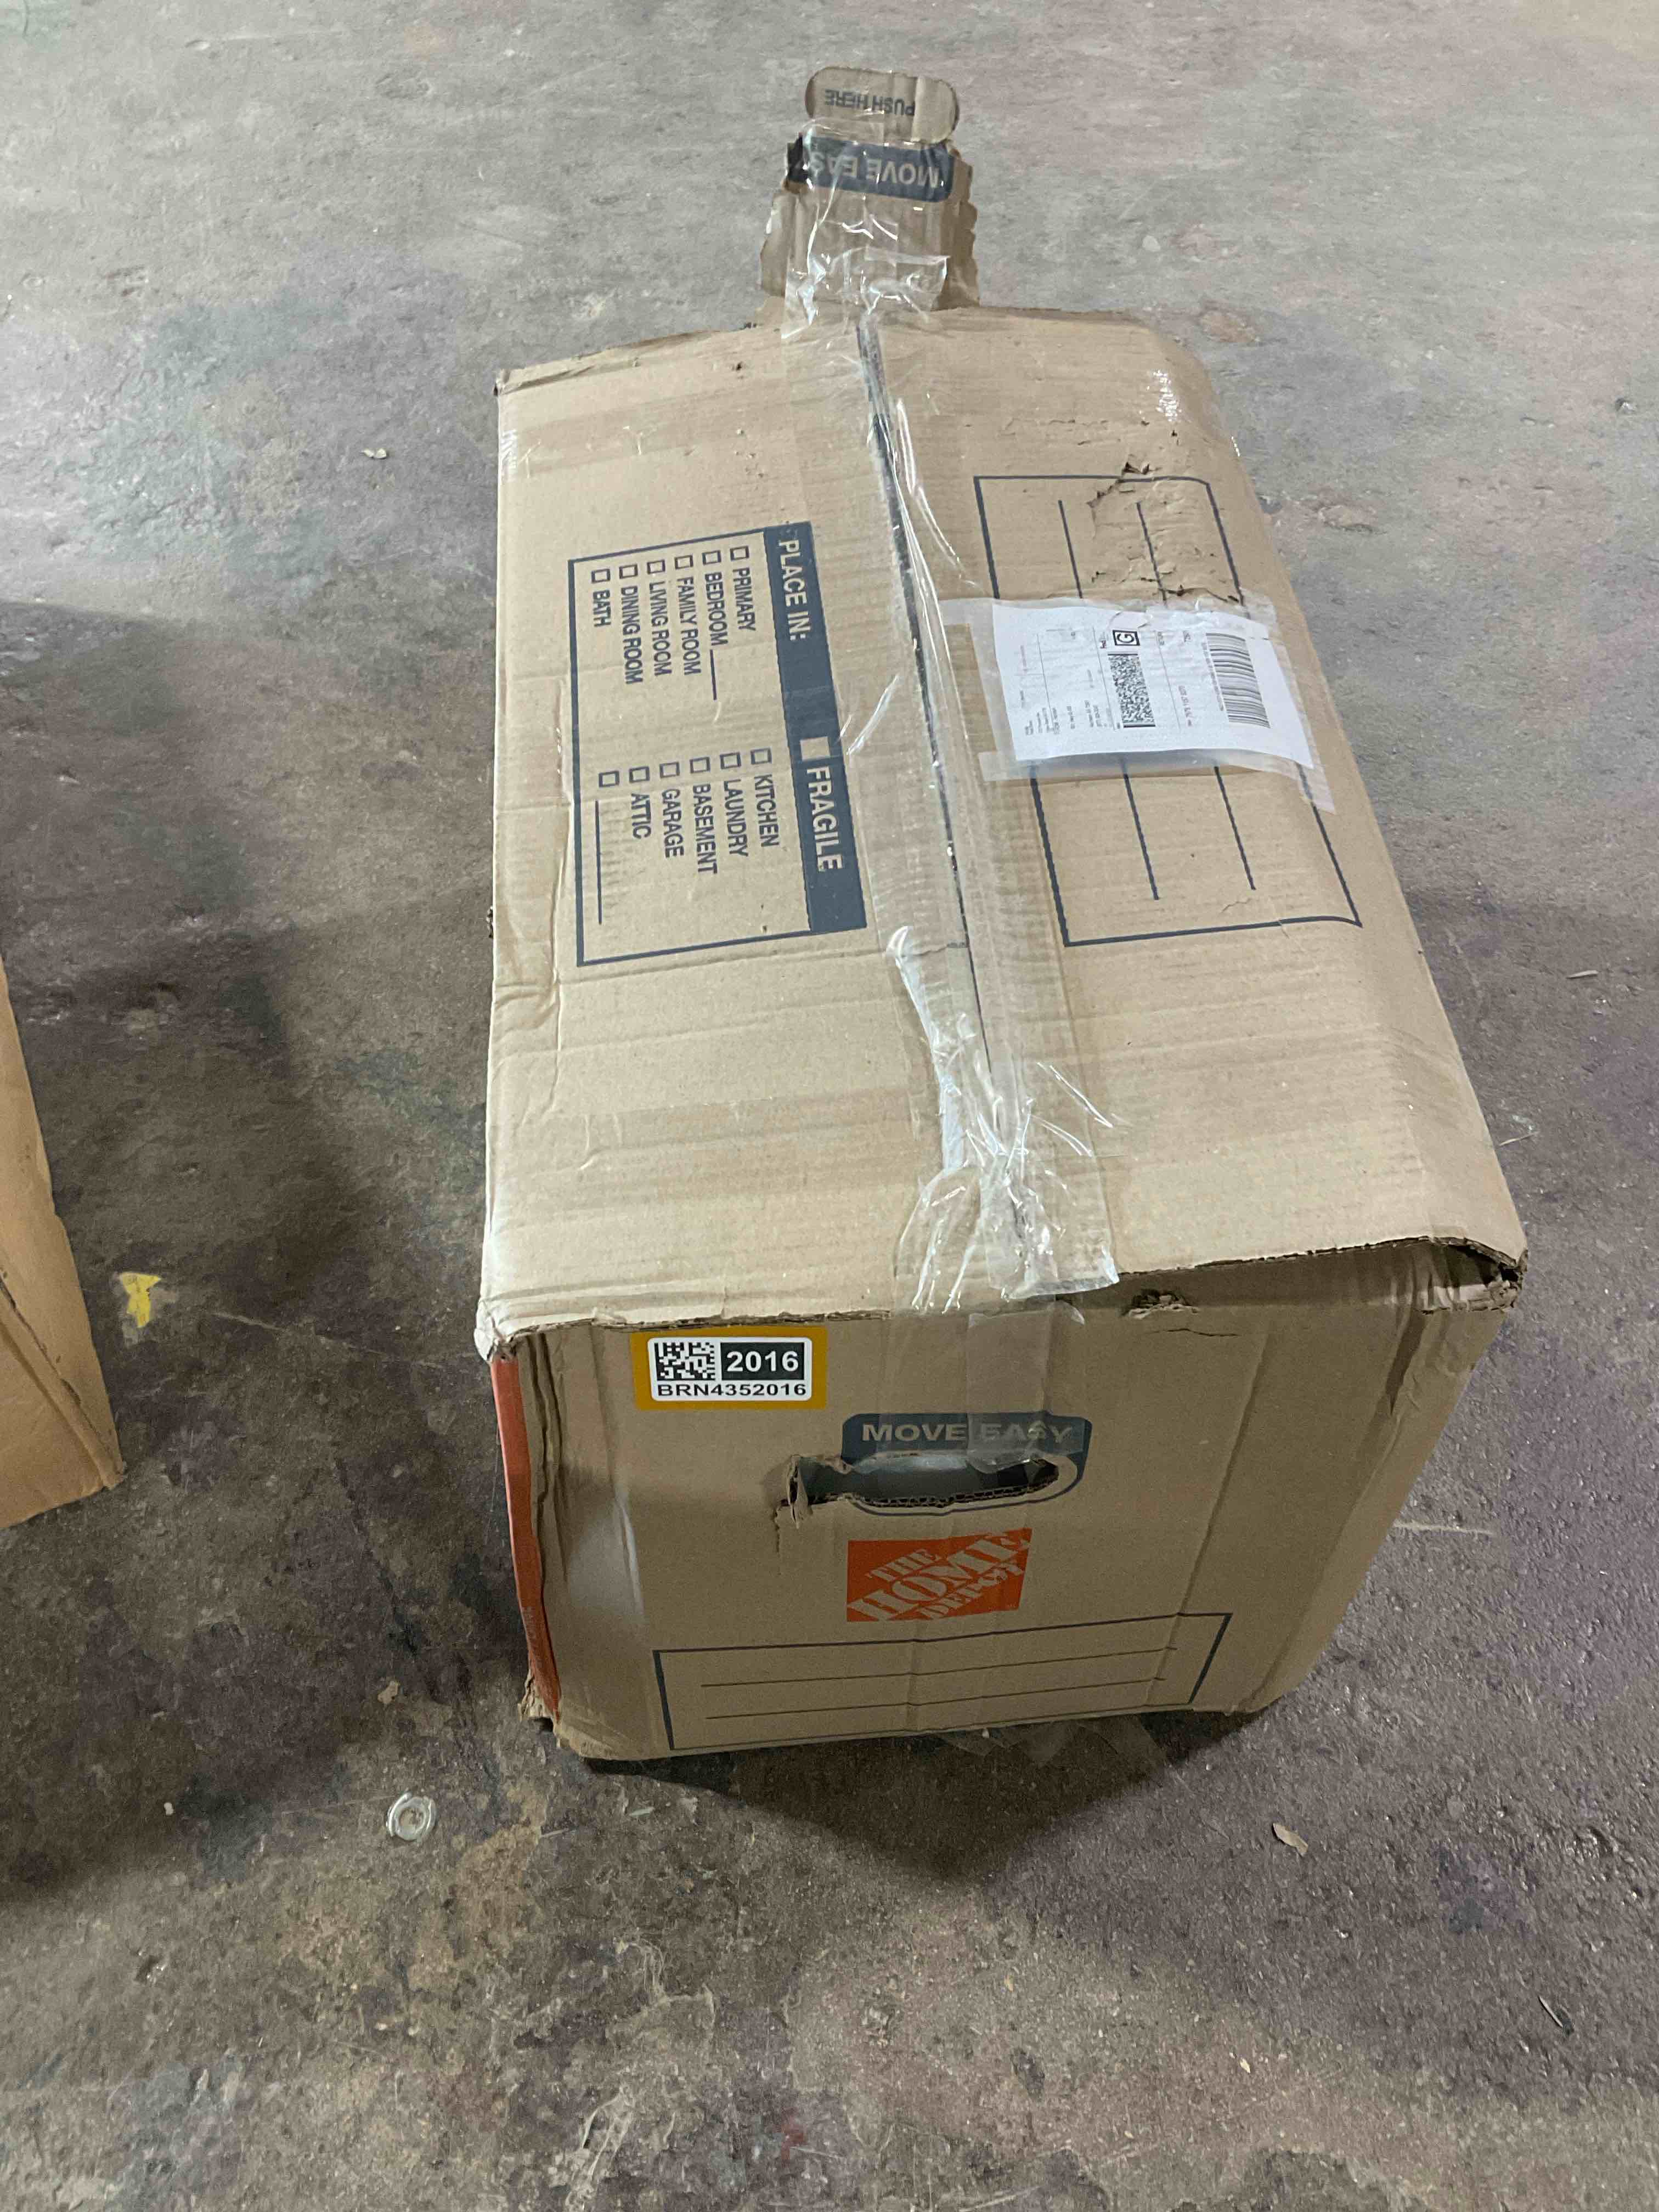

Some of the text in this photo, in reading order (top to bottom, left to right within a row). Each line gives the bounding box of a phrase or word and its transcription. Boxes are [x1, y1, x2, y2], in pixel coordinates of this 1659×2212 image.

[825, 89, 915, 116] PUSH HERE
[865, 158, 939, 188] MOVE
[592, 590, 612, 628] BATH
[704, 572, 729, 646] BEDROOM
[732, 567, 757, 631] PRIMARY
[778, 540, 811, 641] PLACE IN:
[620, 585, 644, 685] DINING ROOM
[649, 581, 673, 676] LIVING ROOM
[677, 576, 702, 676] FAMILY ROOM
[630, 793, 652, 839] ATTIC
[661, 788, 685, 858] GARAGE
[692, 782, 718, 874] BASEMENT
[723, 779, 749, 857] LAUNDRY
[754, 774, 780, 848] KITCHEN
[806, 766, 843, 872] FRAGILE
[657, 1383, 807, 1397] BRN4352016
[726, 1350, 799, 1373] 2016
[861, 1420, 1072, 1444] MOVE EASY
[846, 1532, 1031, 1621] HOME
[865, 1549, 940, 1582] THE
[917, 1561, 1024, 1620] DEPOT
